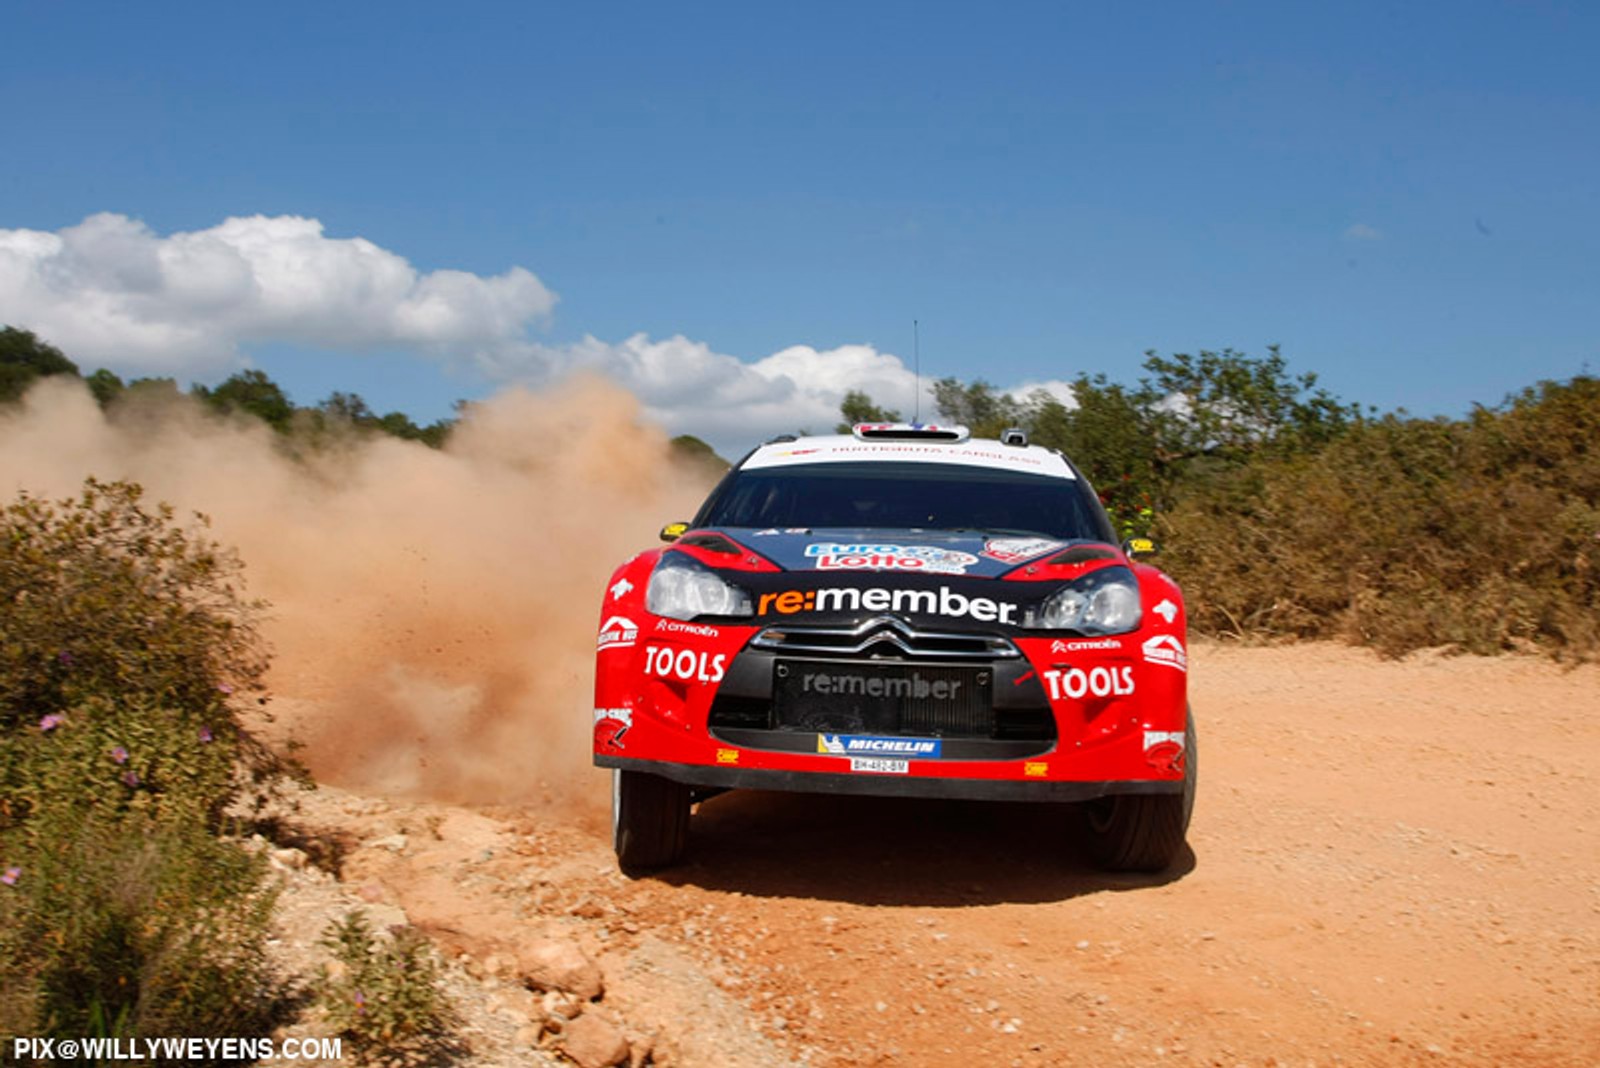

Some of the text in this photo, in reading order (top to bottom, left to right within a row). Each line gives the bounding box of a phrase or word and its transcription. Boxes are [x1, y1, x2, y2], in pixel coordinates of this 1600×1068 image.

[758, 586, 1017, 625] re:member
[644, 646, 726, 682] TOOLS
[803, 672, 961, 699] re:member
[1044, 666, 1135, 700] TOOLS
[848, 739, 936, 752] MICHELIN
